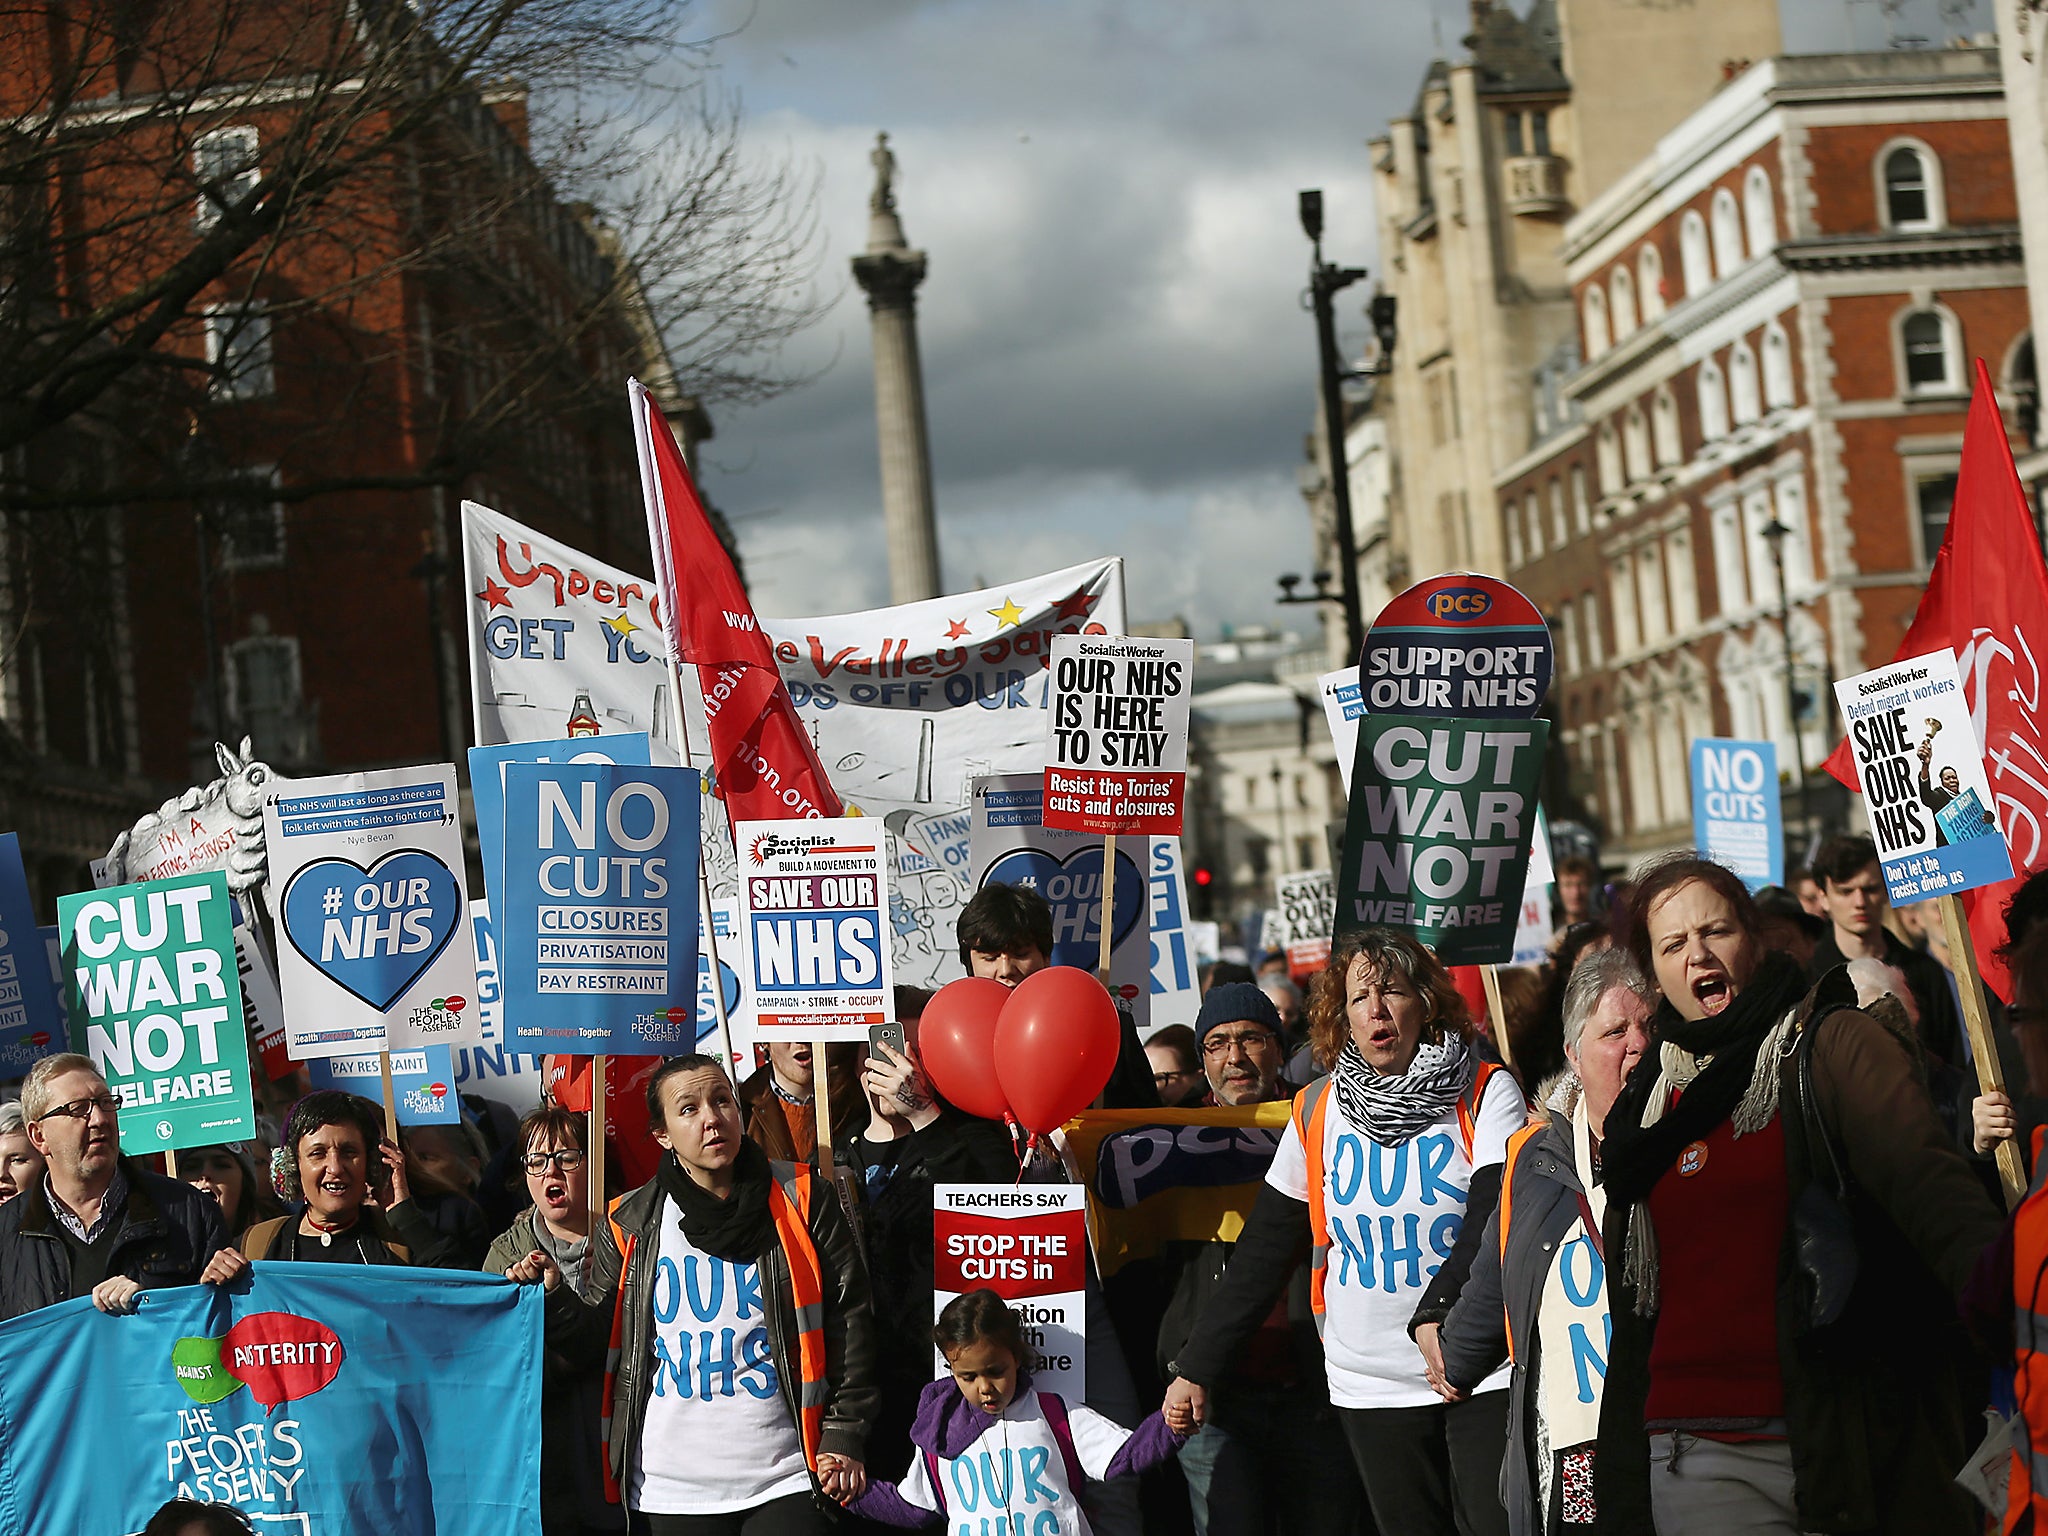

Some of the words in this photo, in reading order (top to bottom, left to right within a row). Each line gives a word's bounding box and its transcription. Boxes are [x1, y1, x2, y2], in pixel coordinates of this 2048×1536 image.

[1435, 593, 1487, 619] pcs
[484, 615, 575, 660] GET
[805, 635, 969, 679] Valley
[1368, 645, 1544, 676] SUPPORT
[849, 680, 933, 707] OFF
[943, 669, 1030, 710] OUR
[1057, 657, 1116, 694] OUR
[1126, 660, 1183, 697] NHS
[1370, 678, 1453, 708] OUR
[1461, 677, 1538, 708] NHS
[1847, 699, 1876, 721] Defend
[1877, 688, 1912, 712] migrant
[1913, 678, 1956, 700] workers
[1055, 693, 1083, 729] IS
[1093, 695, 1166, 731] HERE
[1054, 729, 1091, 765] TO
[1100, 731, 1169, 767] STAY
[1853, 707, 1915, 764] SAVE
[1373, 726, 1532, 785] CUT
[1702, 747, 1764, 793] NO
[1050, 773, 1095, 795] Resist
[1098, 777, 1123, 797] the
[1864, 756, 1917, 808] OUR
[281, 803, 298, 813] The
[300, 800, 319, 811] NHS
[320, 799, 337, 809] will
[338, 798, 354, 807] last
[367, 795, 388, 804] long
[401, 791, 425, 800] there
[427, 789, 441, 797] are
[988, 796, 1004, 805] The
[1005, 795, 1023, 804] NHS
[1049, 795, 1081, 813] cuts
[1084, 797, 1111, 816] and
[1115, 797, 1175, 816] closures
[1364, 785, 1525, 842] WAR
[1705, 791, 1766, 821] CUTS
[190, 817, 207, 838] A
[285, 823, 303, 833] folk
[304, 821, 320, 831] left
[321, 820, 342, 829] with
[344, 818, 359, 827] the
[361, 816, 381, 826] faith
[395, 811, 417, 823] fight
[418, 809, 432, 819] for
[433, 809, 440, 817] it
[538, 780, 671, 852] NO
[990, 815, 1006, 824] folk
[1007, 814, 1022, 823] left
[1874, 800, 1926, 853] NHS
[188, 826, 237, 866] ACTIVIST
[348, 836, 365, 845] Nye
[367, 832, 394, 843] Bevan
[768, 834, 836, 848] Socialist
[538, 855, 670, 899] CUTS
[779, 861, 804, 872] BUILD
[806, 861, 812, 871] A
[813, 860, 861, 871] MOVEMENT
[865, 859, 876, 869] TO
[1358, 840, 1517, 900] NOT
[1909, 859, 1922, 875] let
[1924, 855, 1940, 872] the
[353, 877, 430, 912] OUR
[751, 878, 814, 909] SAVE
[820, 876, 875, 907] OUR
[1891, 878, 1919, 900] racists
[1921, 874, 1948, 893] divide
[1950, 869, 1965, 885] us
[74, 884, 213, 959] CUT
[541, 909, 663, 933] CLOSURES
[1286, 901, 1333, 923] OUR
[1353, 898, 1504, 929] WELFARE
[320, 907, 434, 962] NHS
[539, 944, 665, 960] PRIVATISATION
[756, 916, 877, 986] NHS
[74, 948, 228, 1018] WAR
[539, 975, 571, 989] PAY
[577, 975, 665, 991] RESTRAINT
[413, 1007, 432, 1016] THE
[756, 997, 799, 1008] CAMPAIGN
[808, 996, 839, 1007] STRIKE
[848, 995, 884, 1006] OCCUPY
[422, 1021, 461, 1033] ASSEMBLY
[517, 1027, 543, 1037] Health
[579, 1027, 612, 1039] Together
[636, 1014, 655, 1024] THE
[777, 1014, 866, 1026] www.socialistparty.org.uk
[86, 1006, 229, 1079] NOT
[294, 1032, 319, 1045] Health
[353, 1027, 386, 1039] Together
[642, 1033, 680, 1042] ASSEMBLY
[332, 1061, 354, 1074] PAY
[406, 1090, 422, 1098] THE
[414, 1103, 444, 1114] ASSEMBLY
[1332, 1133, 1468, 1207] OUR
[946, 1193, 1033, 1207] TEACHERS
[1036, 1193, 1068, 1207] SAY
[947, 1234, 1015, 1256] STOP
[1018, 1235, 1067, 1256] THE
[961, 1257, 1028, 1280] CUTS
[1033, 1258, 1053, 1280] in
[653, 1254, 764, 1324] OUR
[655, 1326, 779, 1401] NHS
[177, 1408, 218, 1437] THE
[951, 1445, 1060, 1513] OUR
